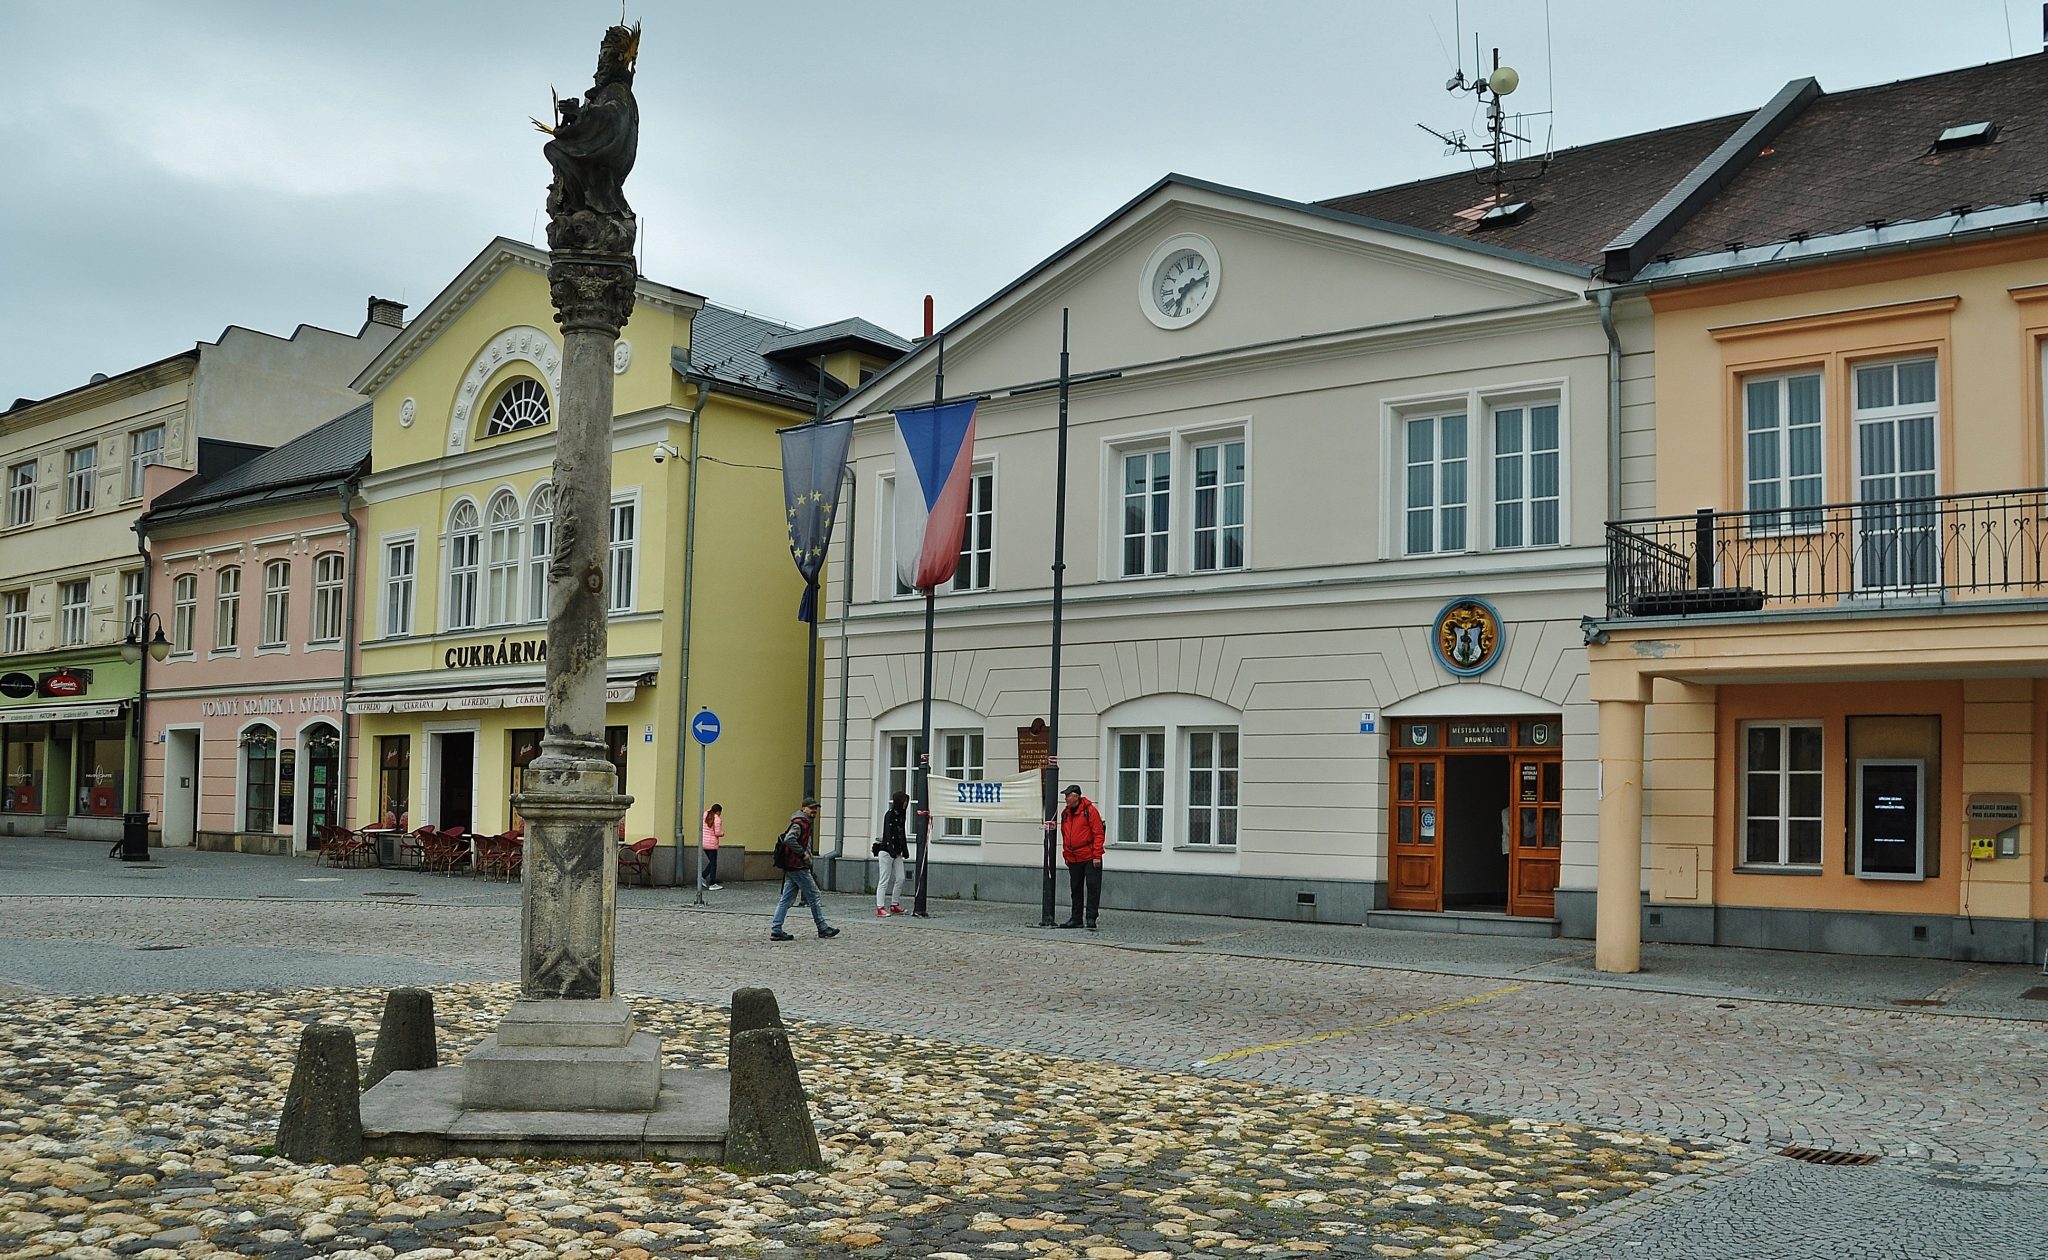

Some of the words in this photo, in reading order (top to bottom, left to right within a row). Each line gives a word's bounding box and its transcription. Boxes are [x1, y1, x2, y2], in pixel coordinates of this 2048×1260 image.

[444, 637, 547, 668] CUKRÁRNA
[243, 697, 283, 715] KRÁMEK
[287, 698, 295, 714] A
[358, 703, 380, 711] ALFREDO
[461, 698, 489, 707] ALFREDO
[1482, 726, 1506, 734] POLICIE
[1464, 735, 1493, 743] BRUNTÁL
[957, 782, 1003, 803] START
